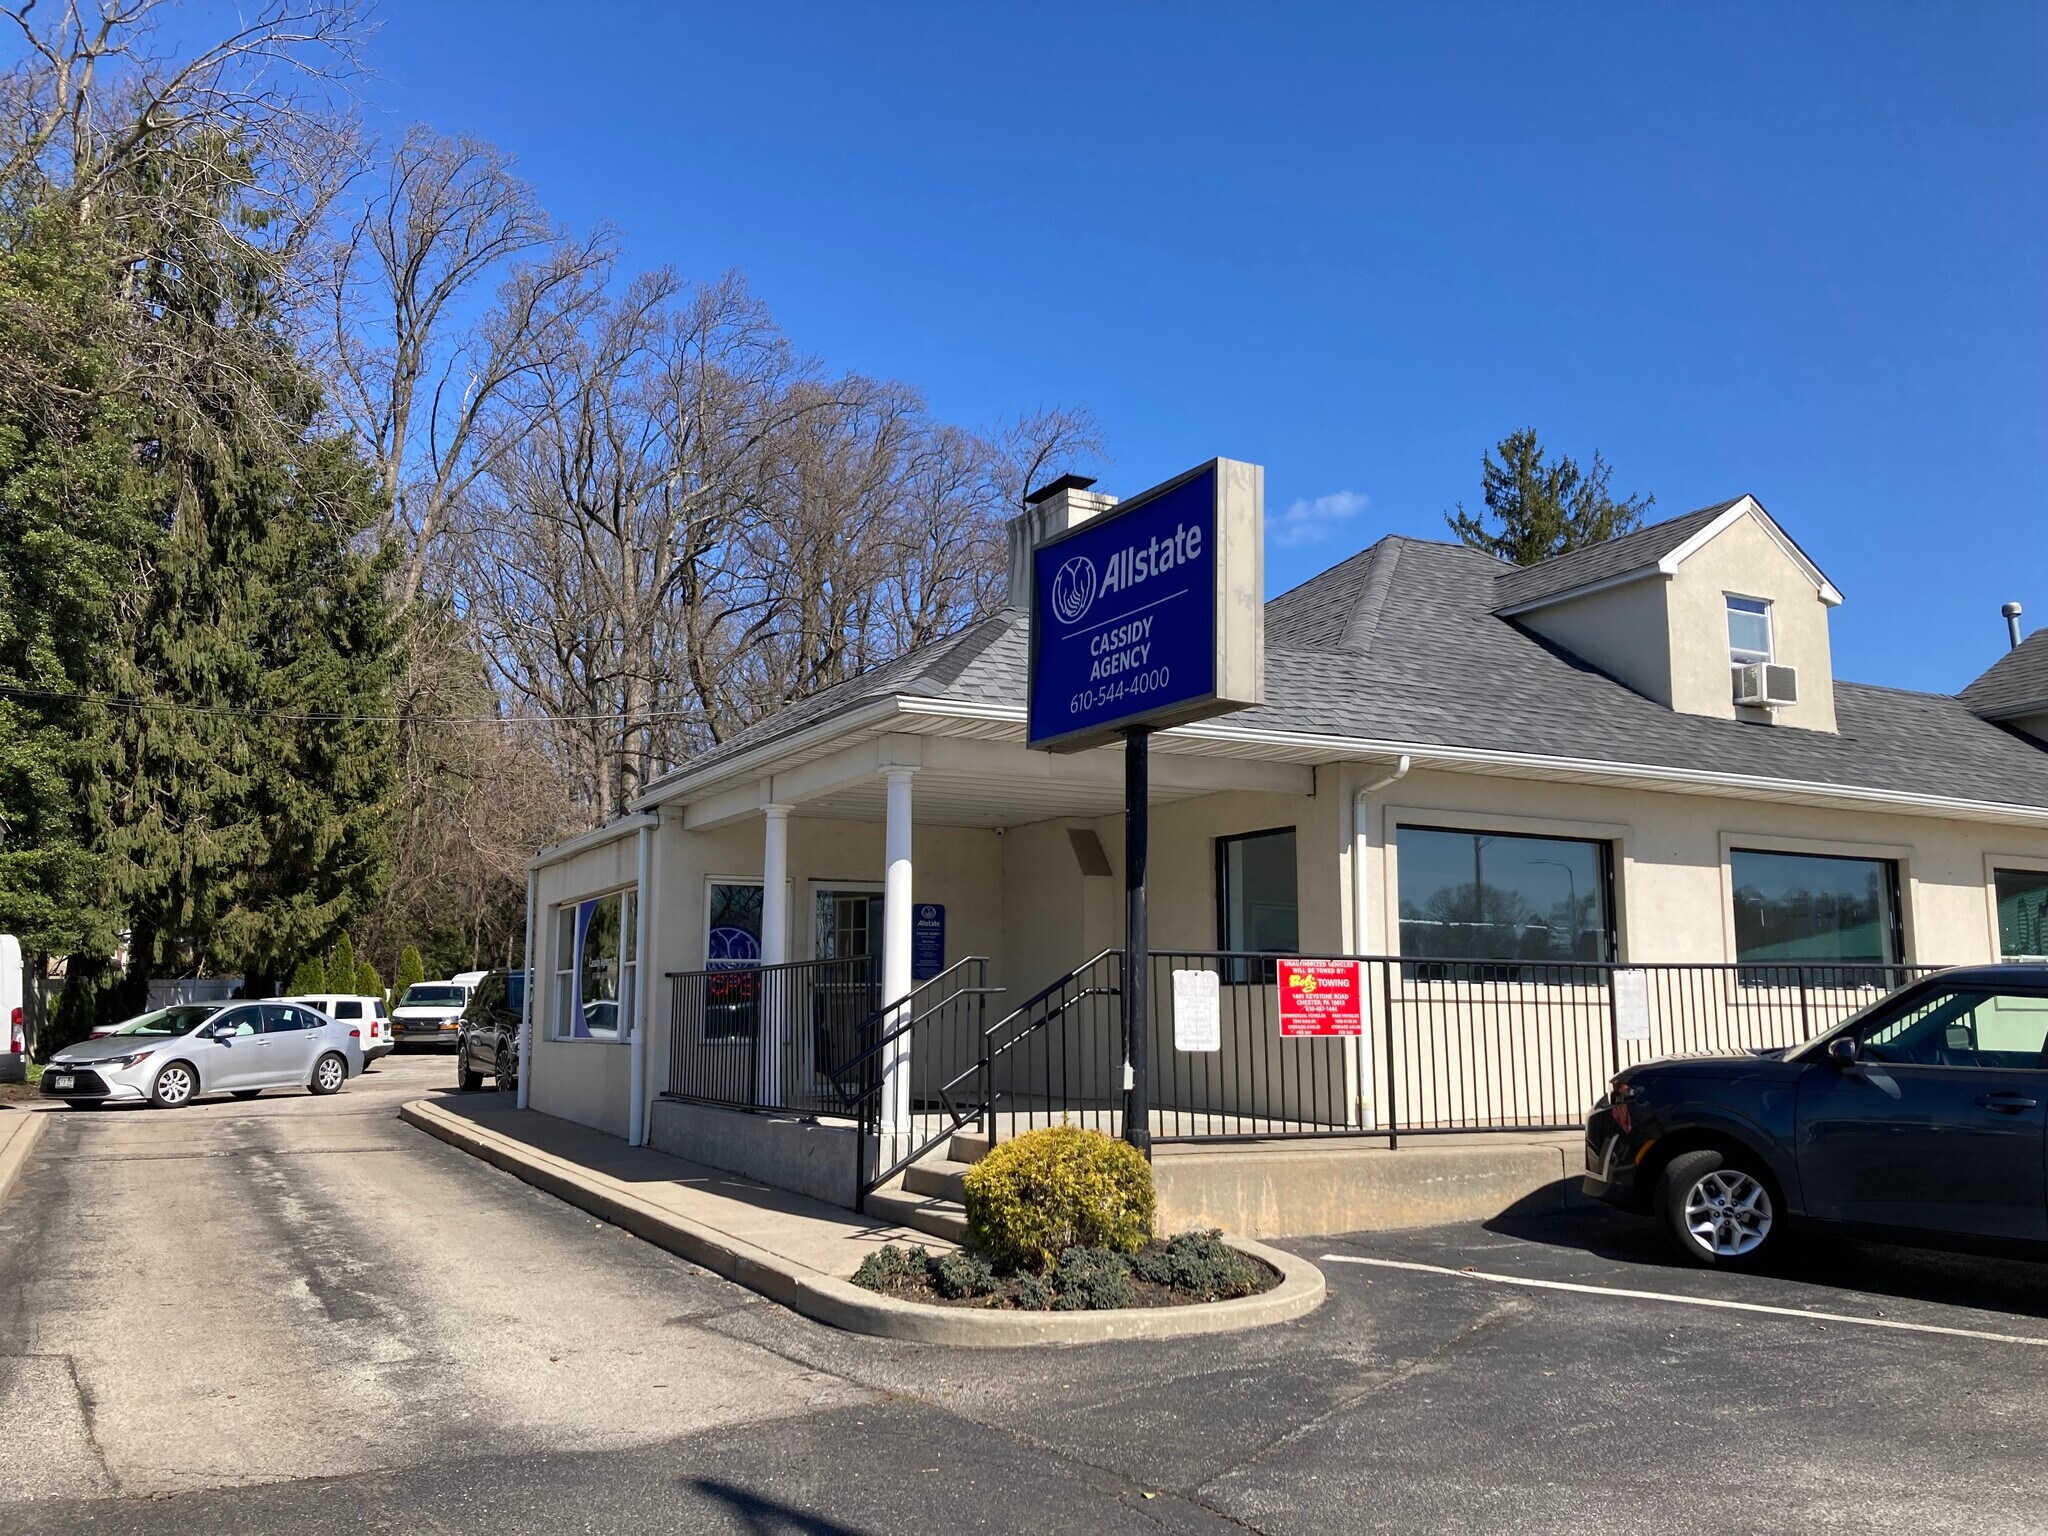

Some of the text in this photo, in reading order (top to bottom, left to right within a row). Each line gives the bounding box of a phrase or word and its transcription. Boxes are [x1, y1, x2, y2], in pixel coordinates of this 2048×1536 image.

[1099, 523, 1201, 599] Allstate
[1090, 615, 1153, 657] CASSIDY
[1090, 642, 1151, 681] AGENCY
[1070, 666, 1170, 713] 610-544-4000
[711, 971, 758, 996] OPE
[1317, 978, 1350, 987] TOWING
